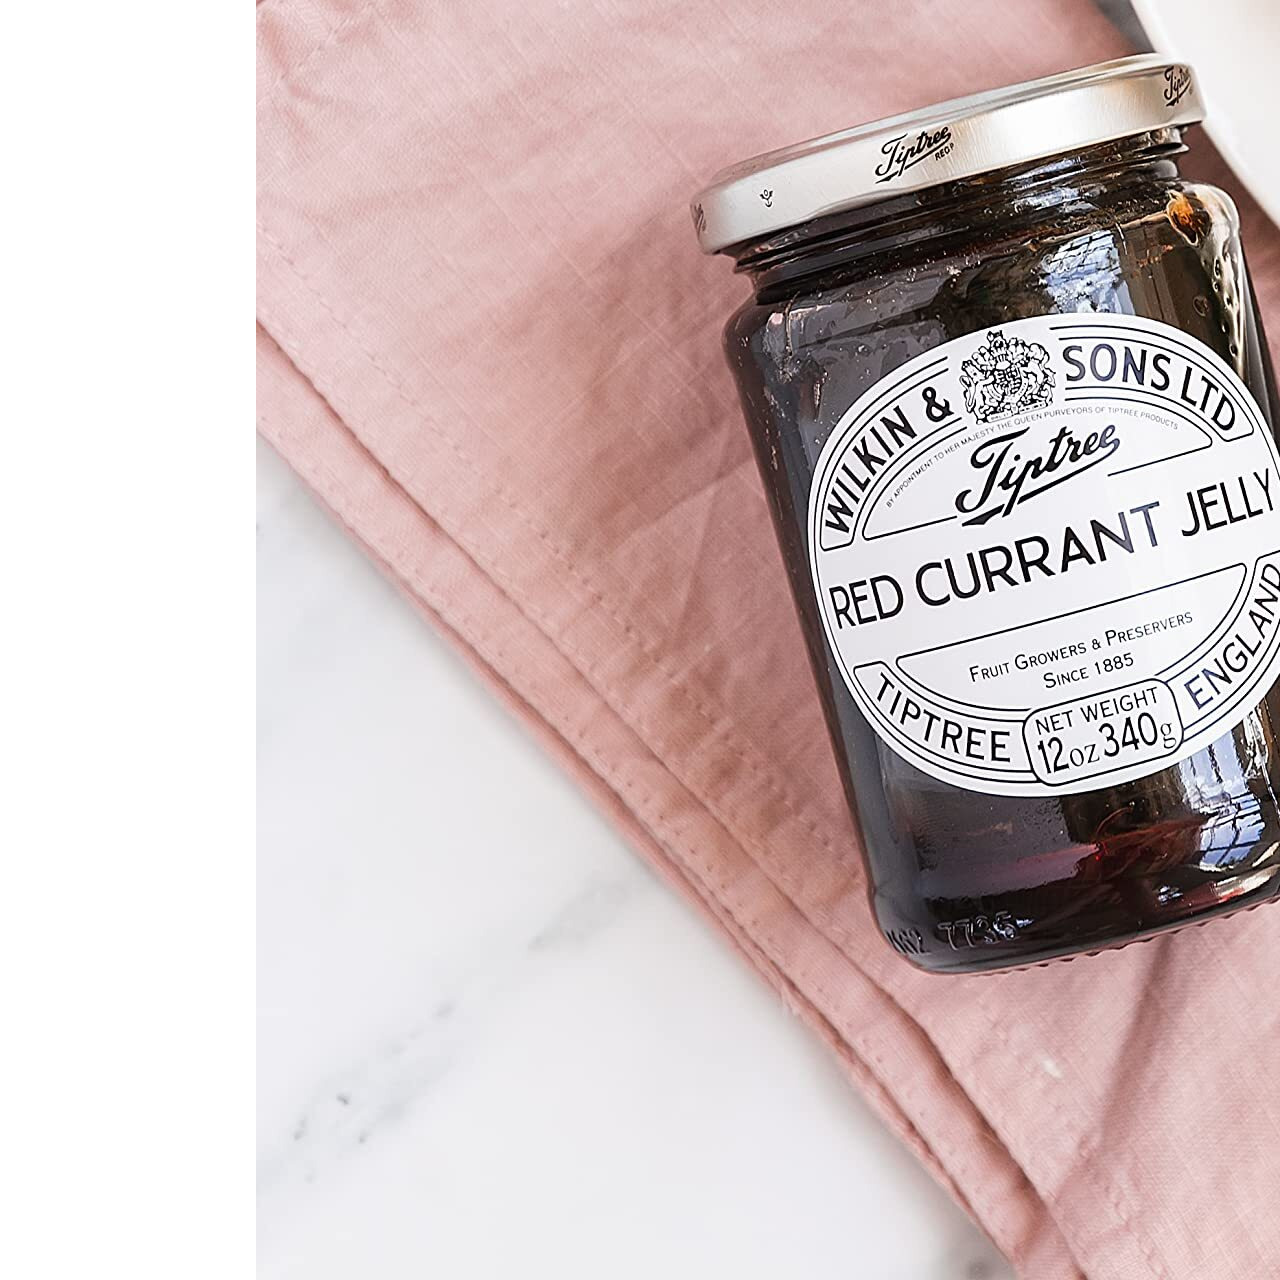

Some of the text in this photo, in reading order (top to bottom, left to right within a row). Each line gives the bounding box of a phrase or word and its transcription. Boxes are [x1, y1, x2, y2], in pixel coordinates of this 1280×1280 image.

[875, 126, 952, 184] Tiptree
[825, 343, 1237, 534] WILKIN & SONS LTD
[886, 497, 895, 508] BY
[893, 458, 934, 498] APPOINTMENT
[933, 451, 945, 462] TO
[944, 441, 961, 455] HER
[960, 426, 996, 446] MAJESTY
[996, 420, 1013, 431] THE
[1013, 412, 1043, 426] QUEEN
[1044, 406, 1094, 419] PURVEYORS
[1094, 406, 1104, 414] OF
[1108, 406, 1139, 418] TIPTREE
[1140, 411, 1179, 431] PRODUCTS
[955, 424, 1120, 527] Tiptree
[829, 468, 1275, 629] RED CURRANT JELLY
[969, 612, 1193, 683] FRUIT GROWERS & PRESERVERS
[1043, 652, 1134, 689] SINCE 1885
[1186, 562, 1280, 710] ENGLAND
[878, 672, 1012, 763] TIPTREE
[1035, 686, 1158, 735] NET WEIGHT
